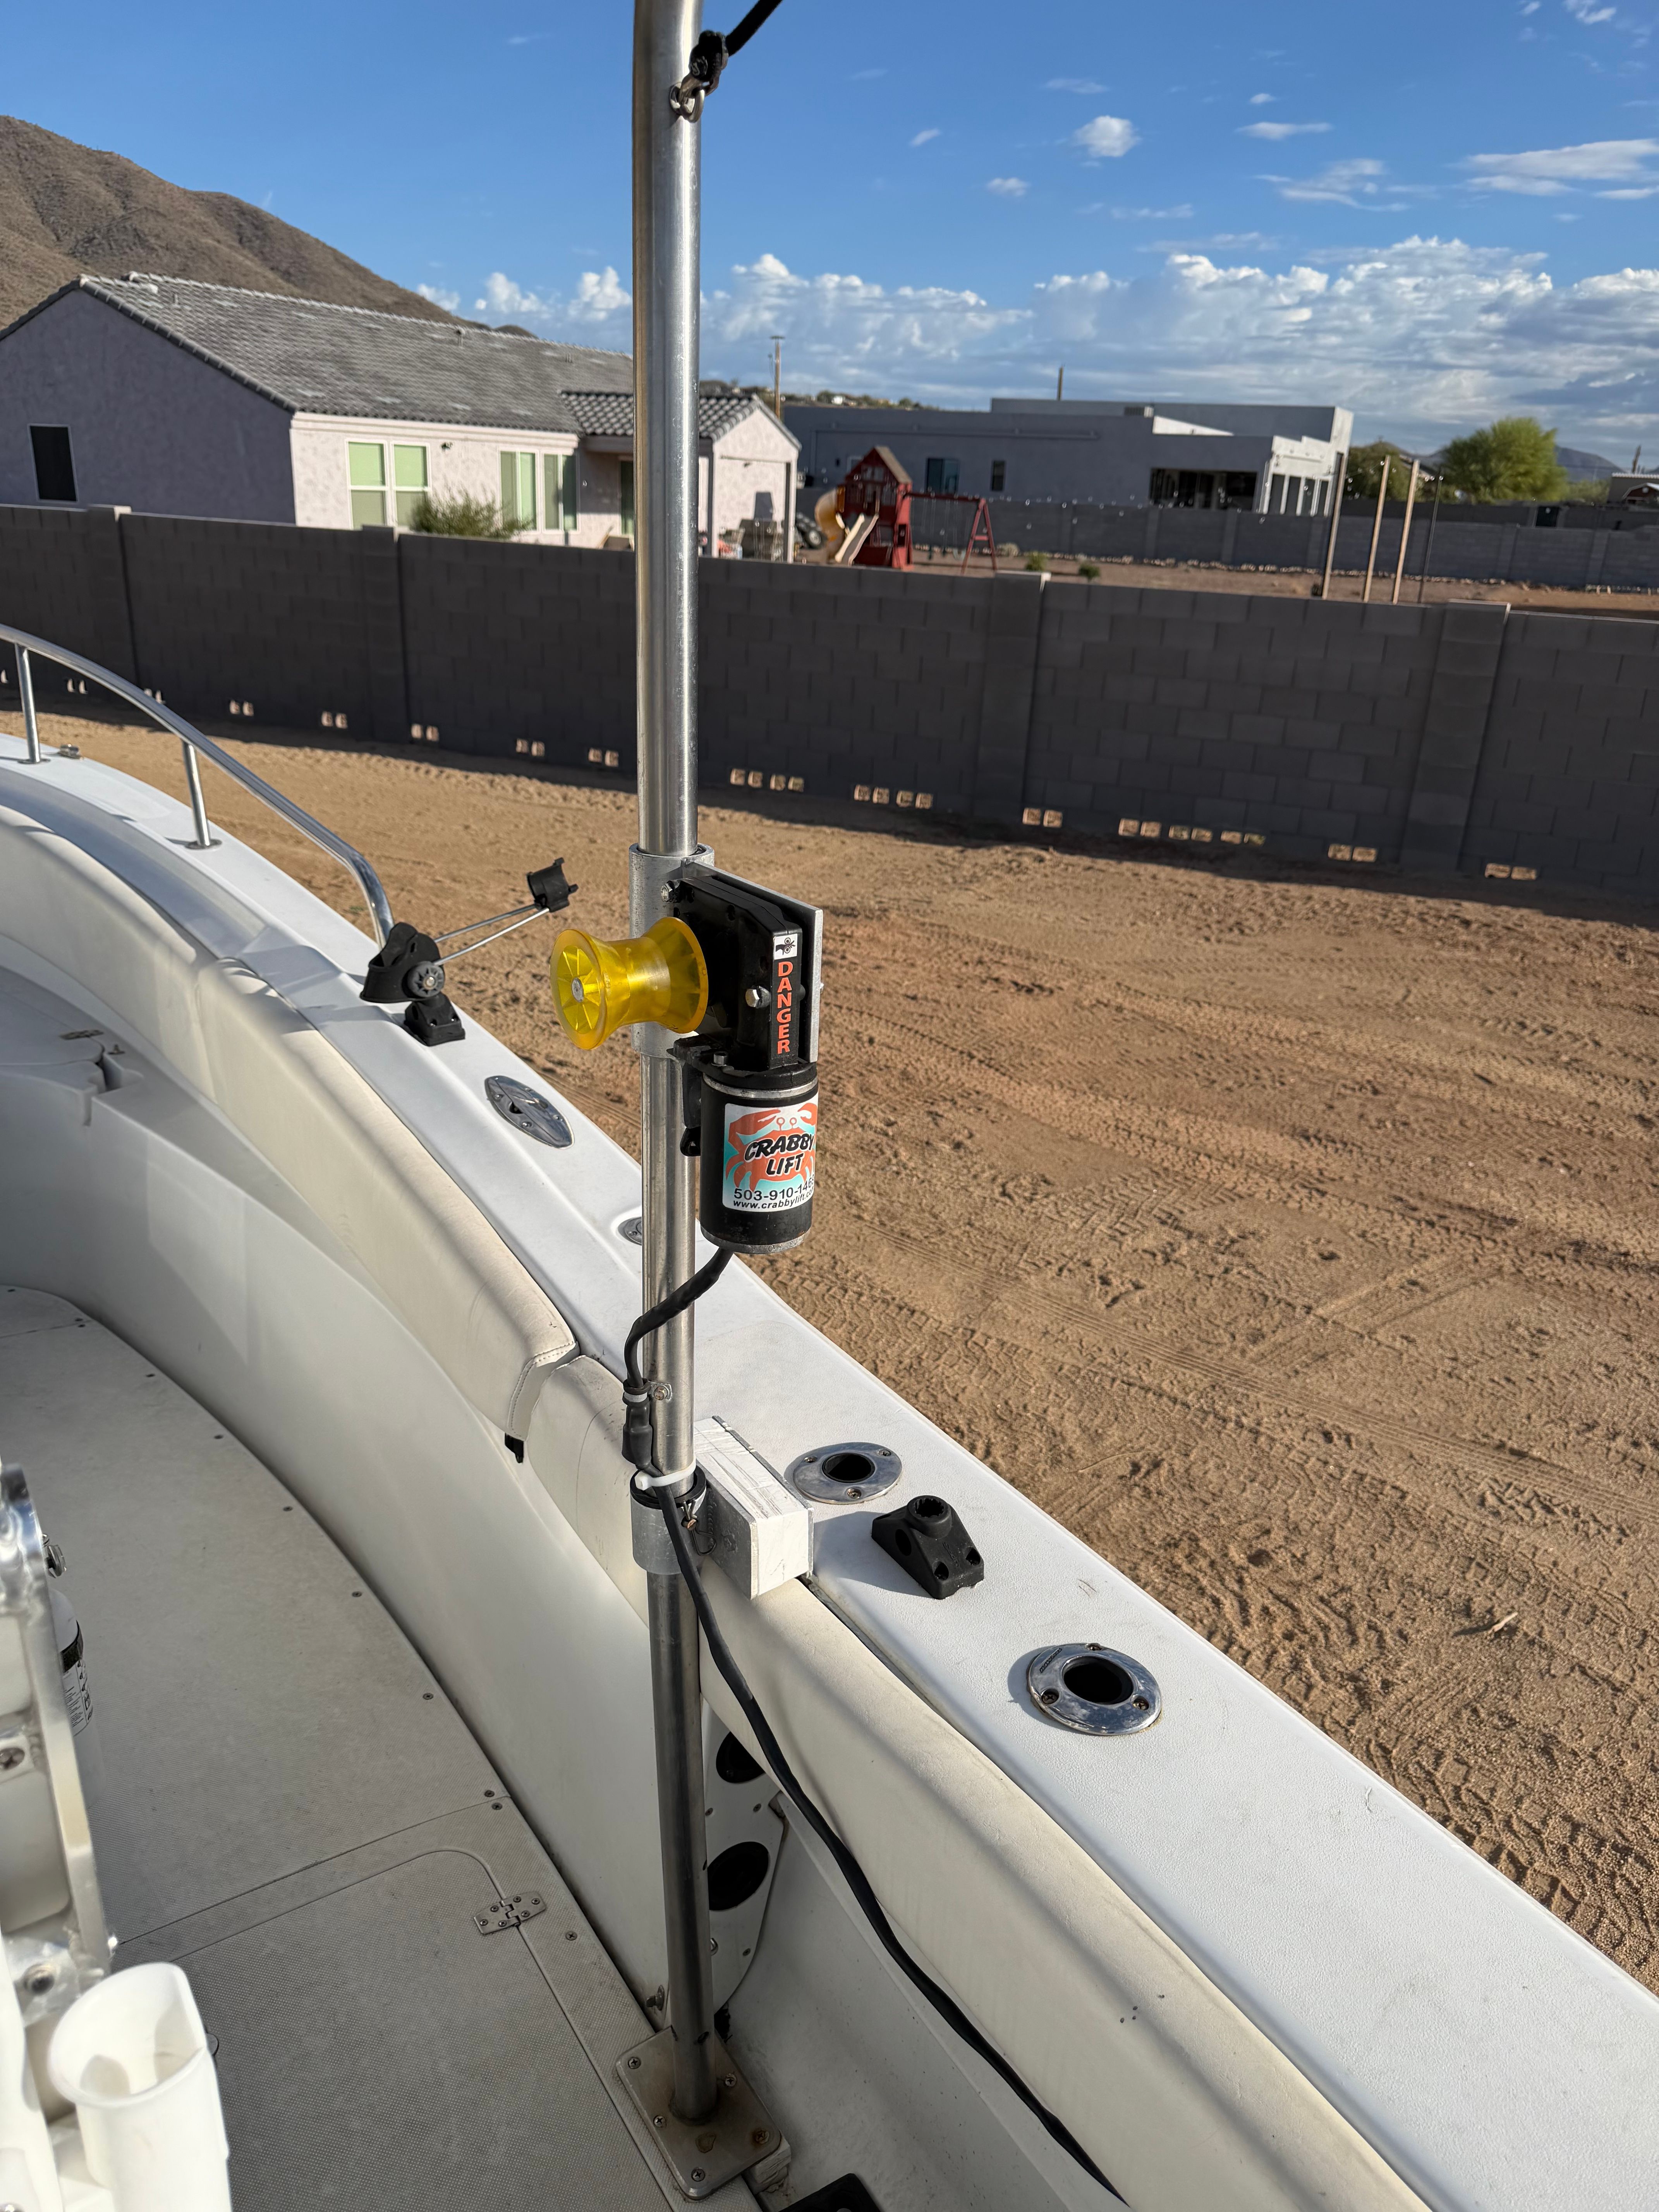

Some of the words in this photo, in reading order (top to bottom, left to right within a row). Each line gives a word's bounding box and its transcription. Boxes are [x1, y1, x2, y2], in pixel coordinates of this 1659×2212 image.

[776, 961, 793, 1054] DANGER
[745, 1133, 814, 1161] CRABBY
[766, 1153, 804, 1175] LIFT
